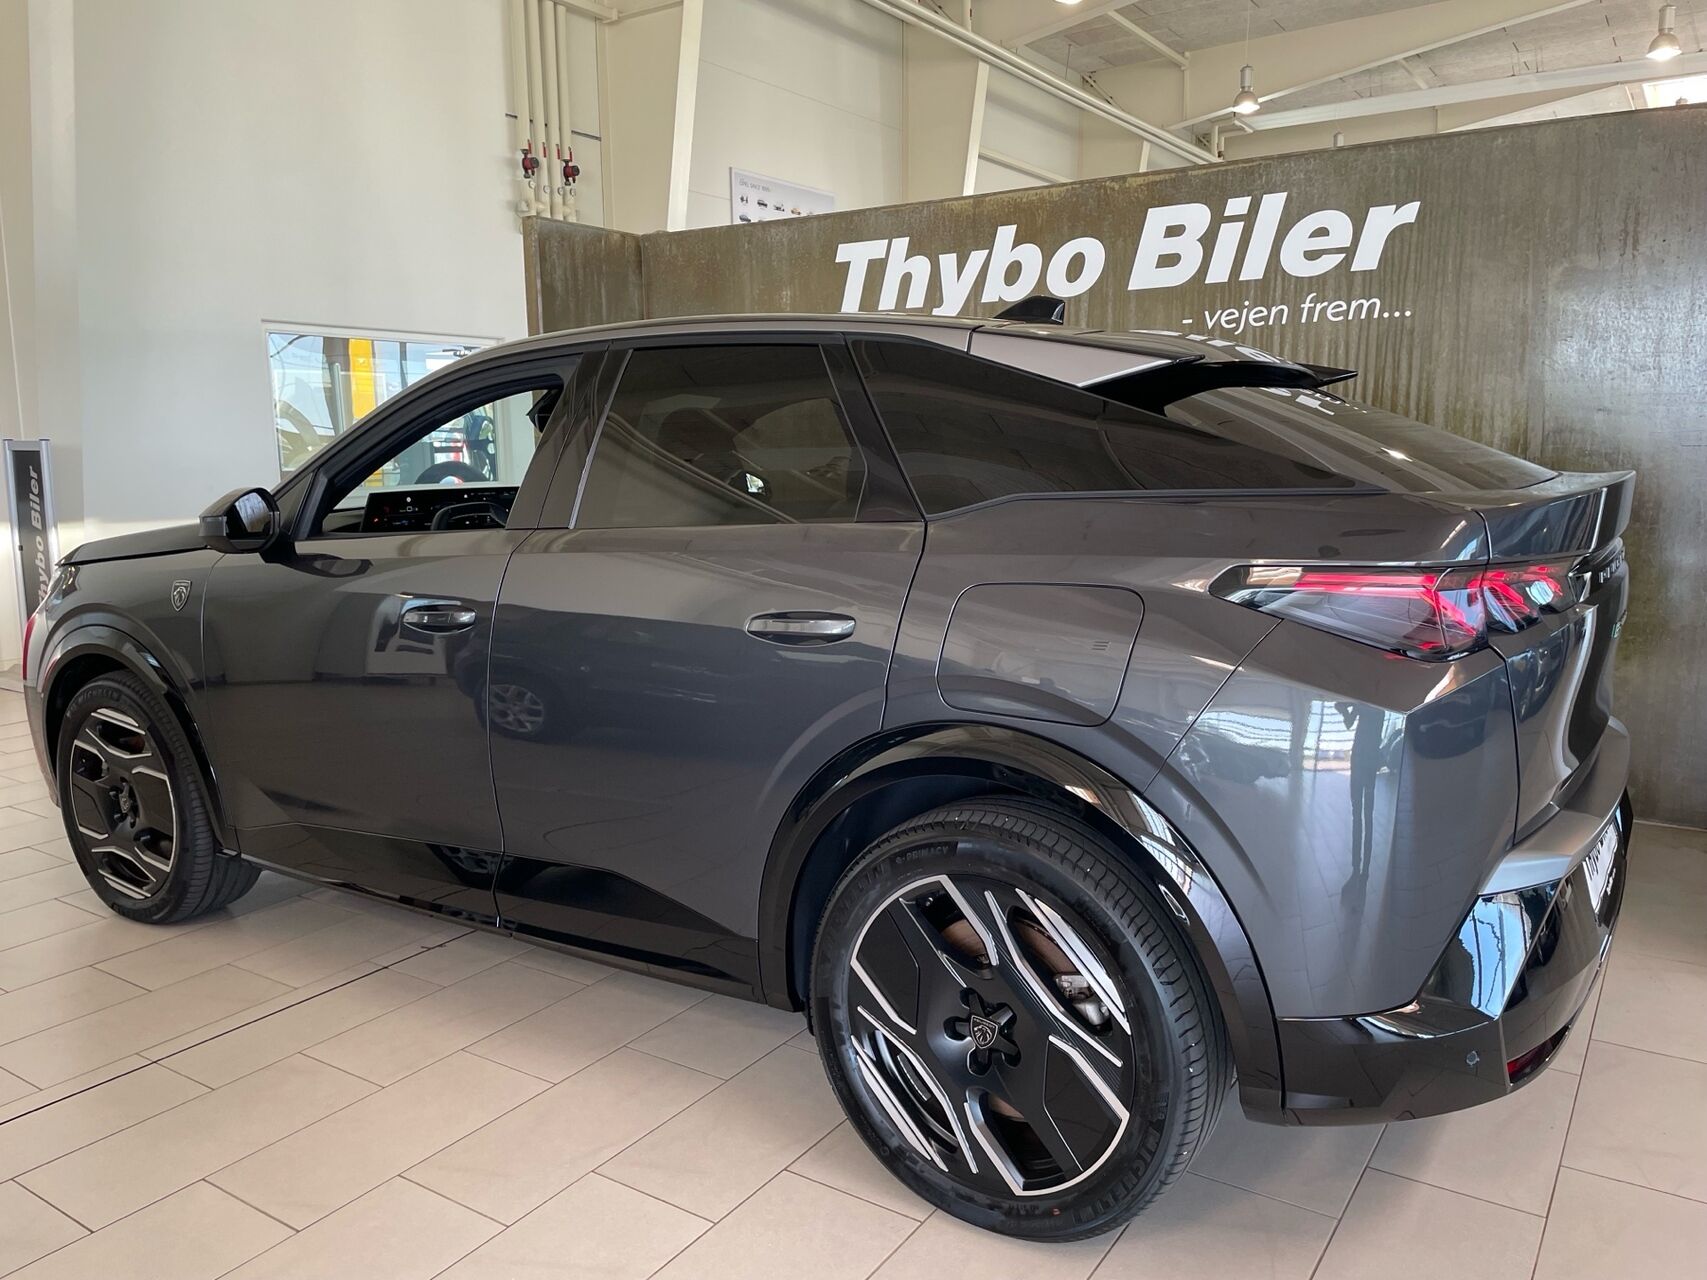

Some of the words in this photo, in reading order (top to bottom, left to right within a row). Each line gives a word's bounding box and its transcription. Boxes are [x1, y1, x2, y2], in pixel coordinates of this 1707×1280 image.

[835, 224, 1106, 315] Thybo
[1127, 191, 1421, 291] Biler
[1203, 300, 1290, 336] vejen
[1299, 292, 1413, 325] frem...
[29, 465, 43, 531] Biler
